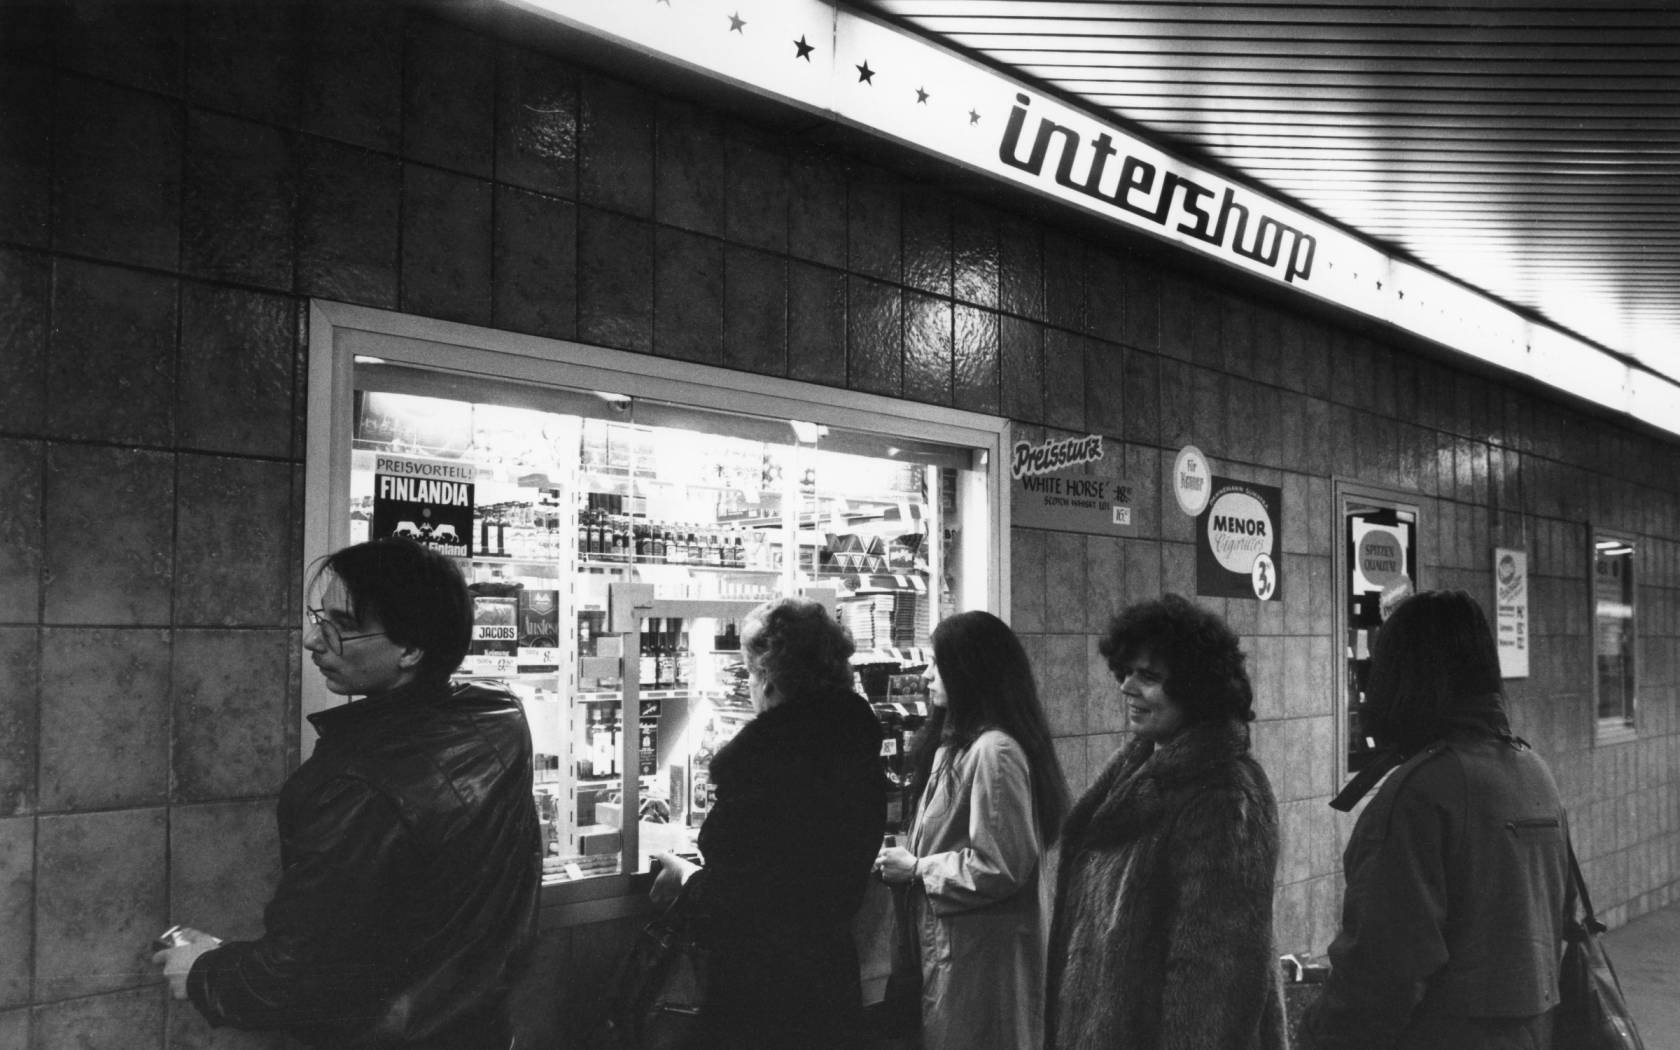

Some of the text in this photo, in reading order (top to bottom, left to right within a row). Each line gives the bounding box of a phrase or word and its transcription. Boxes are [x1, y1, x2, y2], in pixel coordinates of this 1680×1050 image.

[999, 93, 1317, 283] intershop
[1012, 437, 1103, 477] Preissturz
[376, 458, 472, 480] PREISVORTEIL!
[380, 475, 469, 507] FINLANDIA
[1022, 477, 1062, 495] WHITE
[1213, 515, 1267, 537] MENOR
[478, 626, 515, 639] JACOBS
